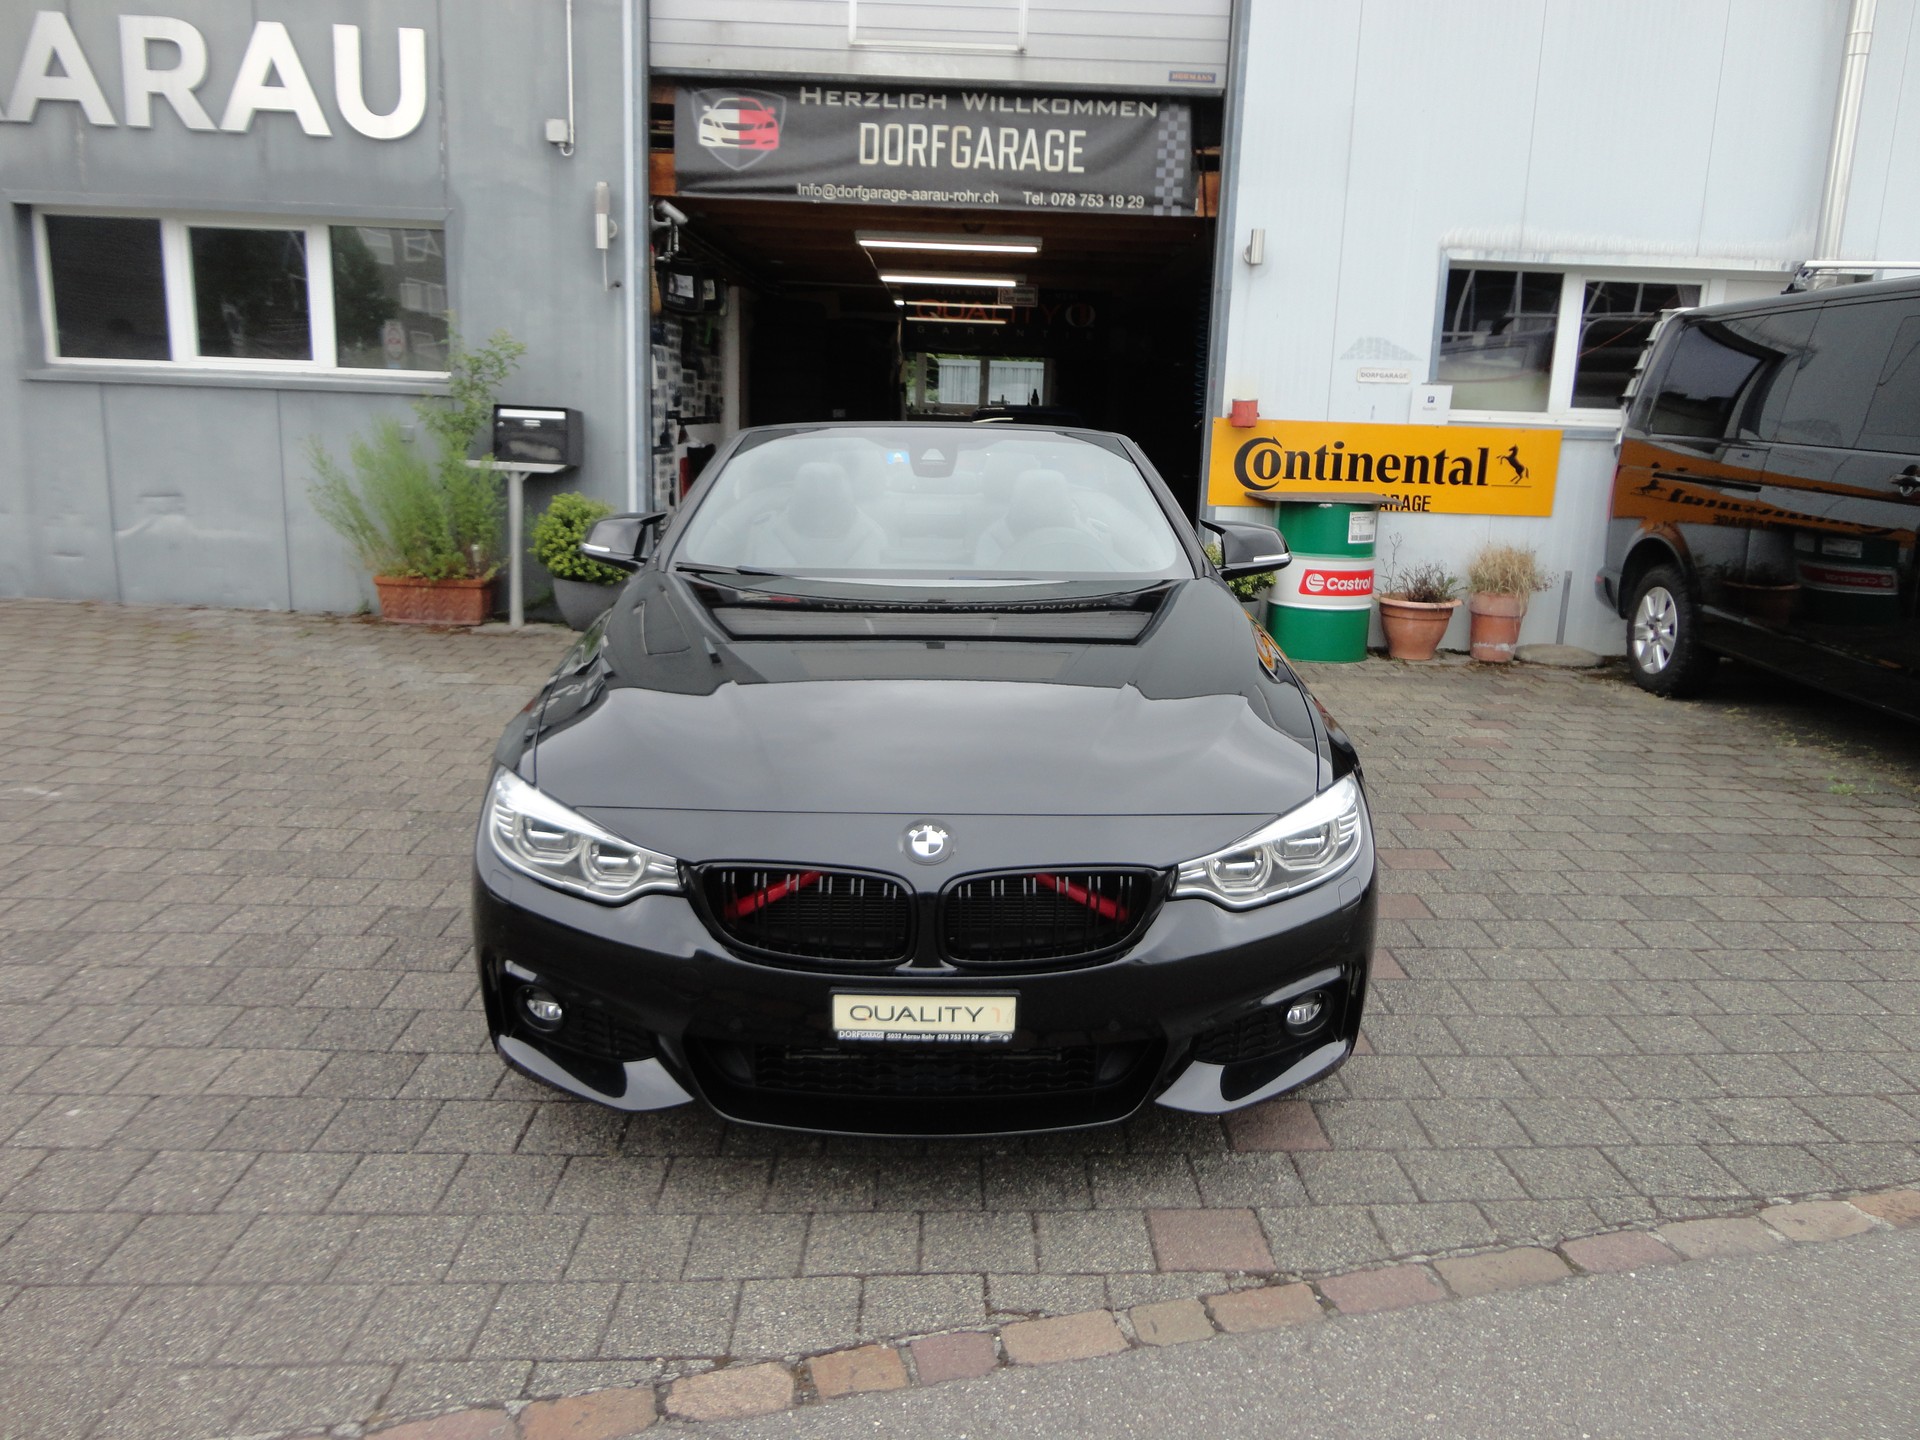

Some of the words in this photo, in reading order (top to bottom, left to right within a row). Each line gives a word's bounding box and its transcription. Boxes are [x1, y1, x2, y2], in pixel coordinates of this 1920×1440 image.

[0, 11, 427, 140] ARAU
[800, 87, 947, 111] HERZLICH
[962, 92, 1157, 118] WILLKOMMEN
[859, 122, 1087, 173] DORFGARAGE
[797, 183, 999, 204] Info@dorfgarage-aarau-rohr.ch
[1023, 191, 1047, 206] Tel.
[1051, 193, 1076, 207] 078
[1079, 194, 1104, 208] 753
[1109, 195, 1124, 208] 19
[1127, 195, 1144, 209] 29
[1233, 436, 1489, 491] Continental
[1379, 493, 1432, 512] ARAGE
[1326, 577, 1371, 590] Castrol
[850, 1005, 984, 1022] QUALITY
